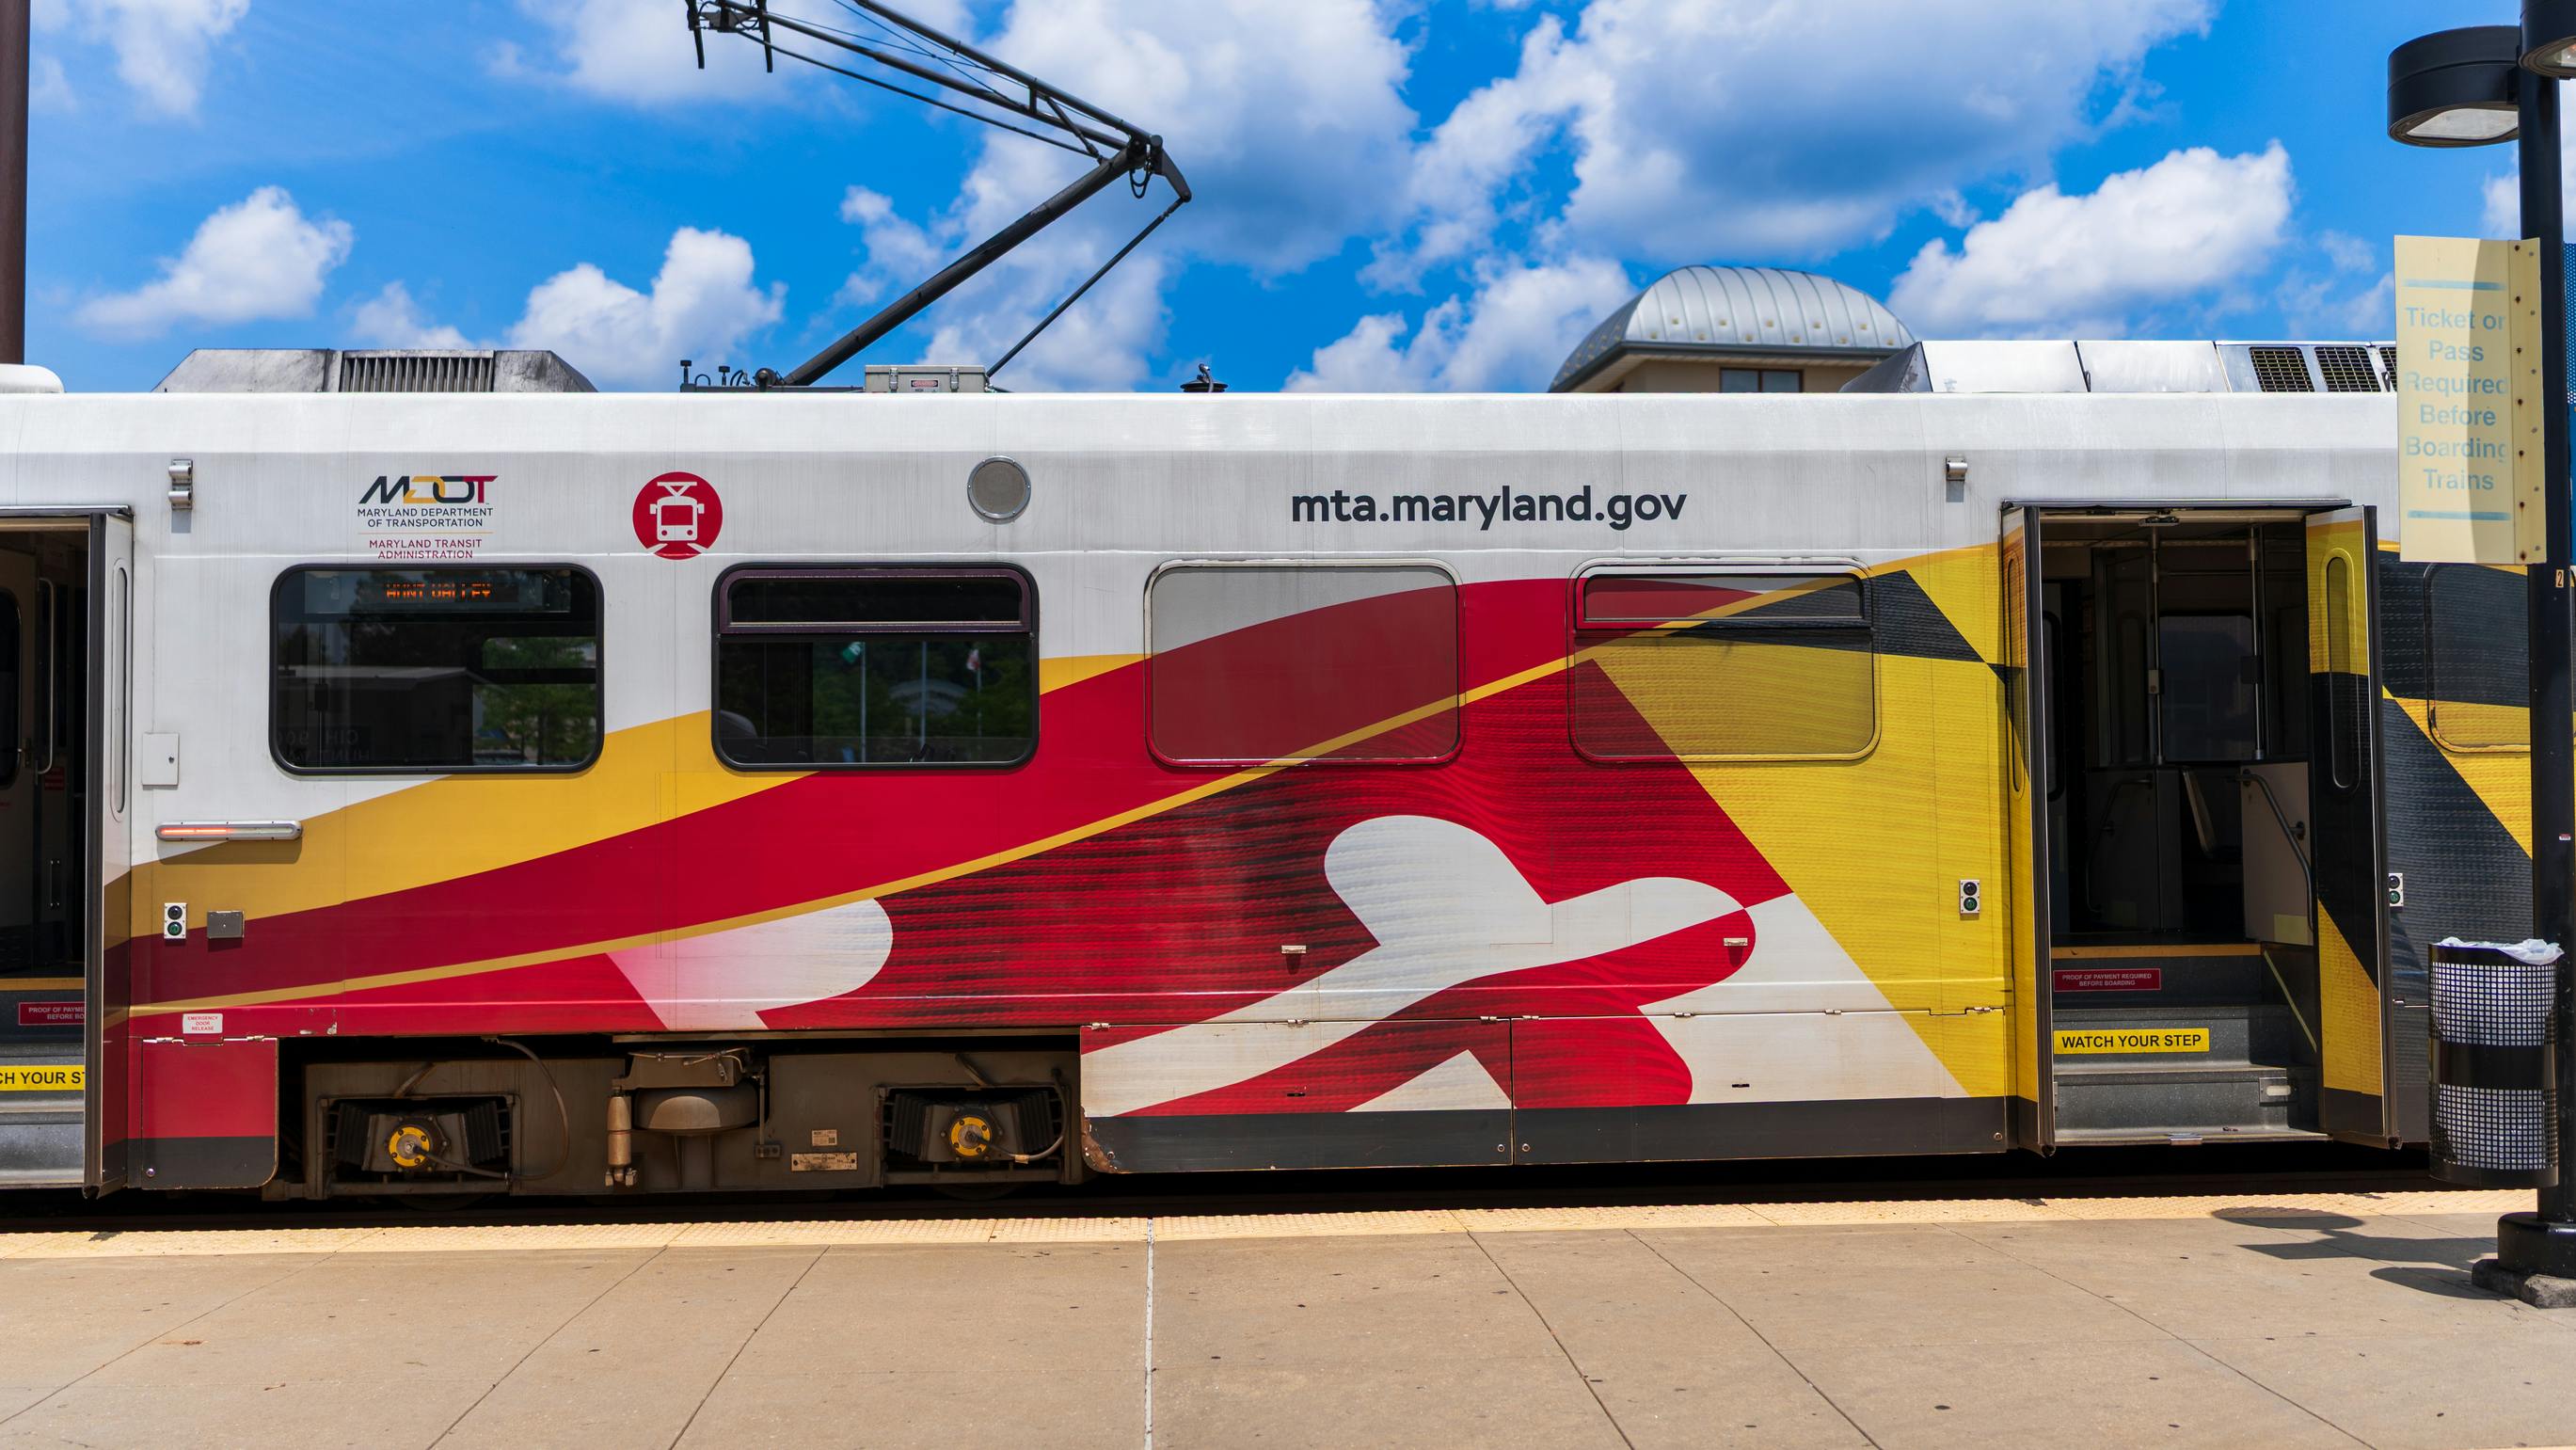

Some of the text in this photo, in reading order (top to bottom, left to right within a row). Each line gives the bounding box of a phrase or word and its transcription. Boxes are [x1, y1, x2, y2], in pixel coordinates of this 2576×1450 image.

[2405, 307, 2505, 330] Ticket or
[2428, 340, 2485, 361] Pass
[2405, 371, 2508, 397] Required
[2420, 404, 2497, 426] Before
[2406, 436, 2506, 463] Boarding
[358, 475, 498, 504] MDOT
[2423, 469, 2495, 490] Trains
[358, 508, 494, 517] MARYLAND DEPARTMENT
[1291, 486, 1688, 532] mta.maryland.gov
[368, 518, 483, 528] OF TRANSPORTATION
[369, 539, 483, 549] MARYLAND TRANSIT
[378, 550, 473, 560] ADMINISTRATION
[2557, 570, 2563, 586] 2
[2061, 1034, 2202, 1048] WATCH YOUR STEP
[21, 1072, 66, 1084] YOUR
